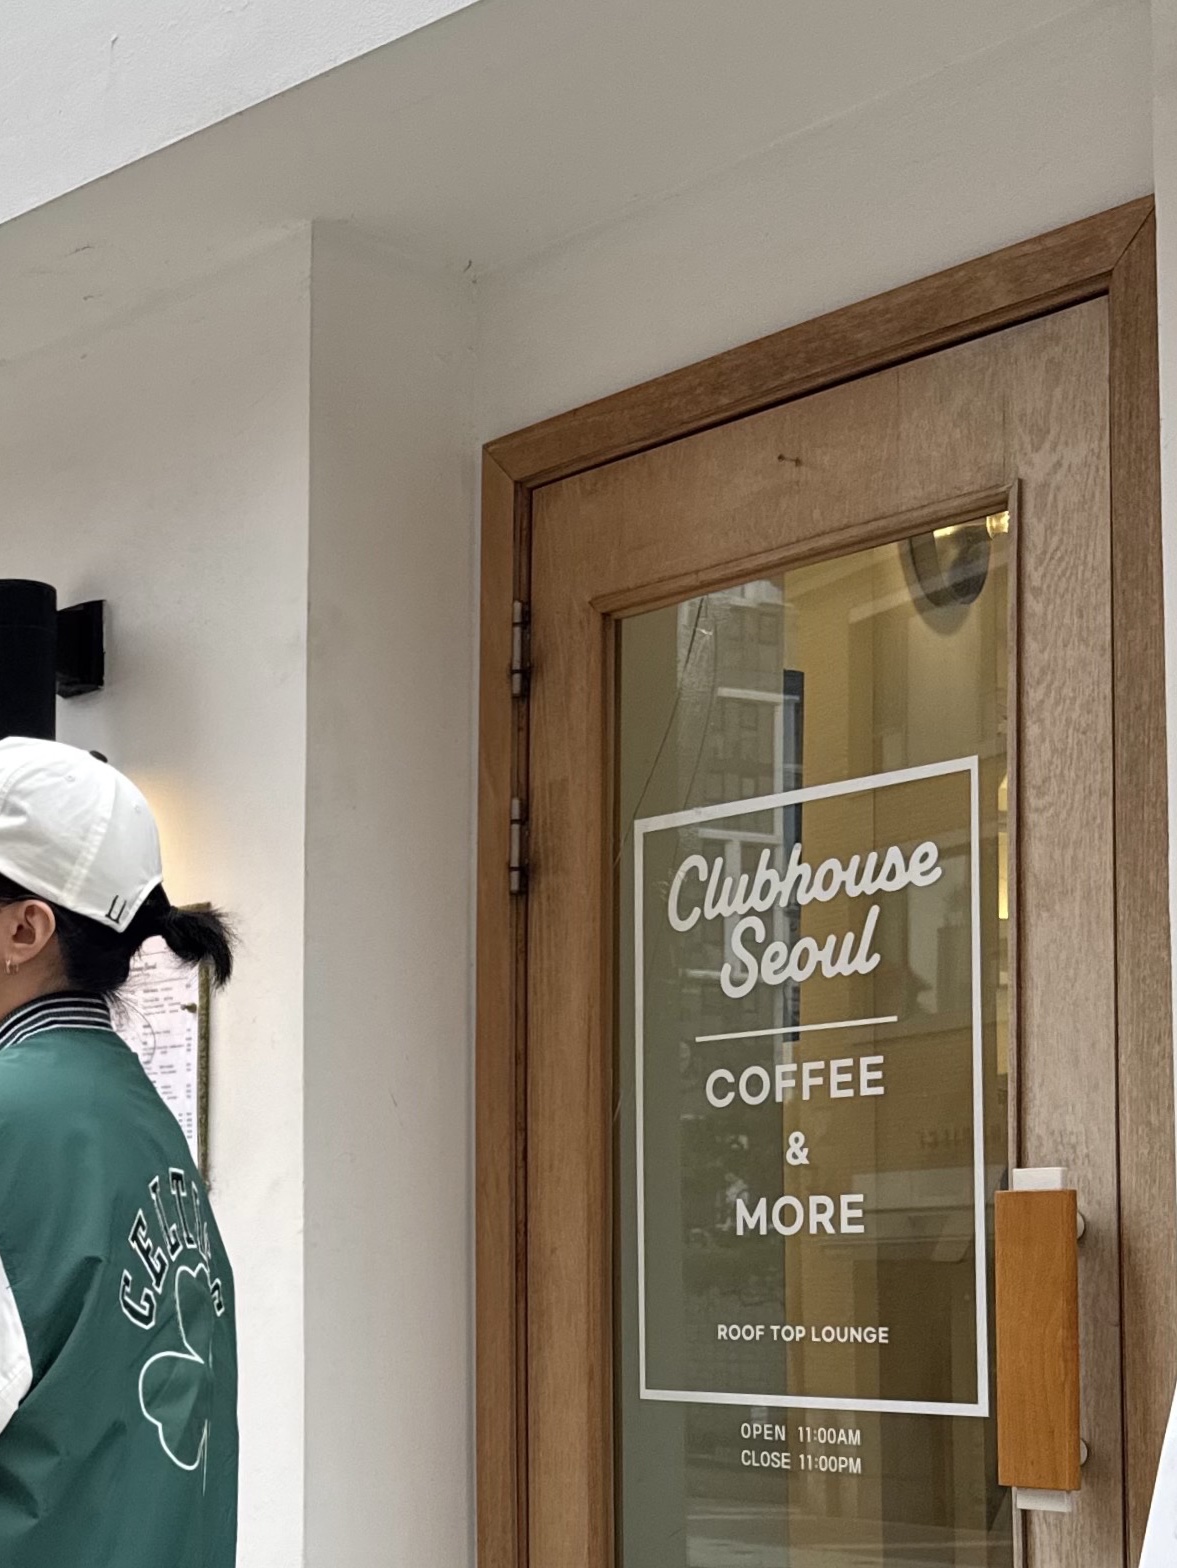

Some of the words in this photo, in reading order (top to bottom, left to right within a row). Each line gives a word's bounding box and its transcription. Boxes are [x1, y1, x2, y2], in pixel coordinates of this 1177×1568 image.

[667, 841, 943, 932] Clubhouse
[720, 904, 881, 999] Seoul
[705, 1055, 885, 1108] COFFEE
[785, 1131, 811, 1166] &
[736, 1193, 865, 1236] MORE
[717, 1324, 765, 1341] ROOF
[770, 1325, 806, 1342] TOP
[811, 1326, 889, 1344] LOUNGE
[740, 1422, 786, 1441] OPEN
[798, 1426, 861, 1446] 11:00AM
[741, 1449, 791, 1469] CLOSE
[799, 1454, 862, 1474] 11:00PM
